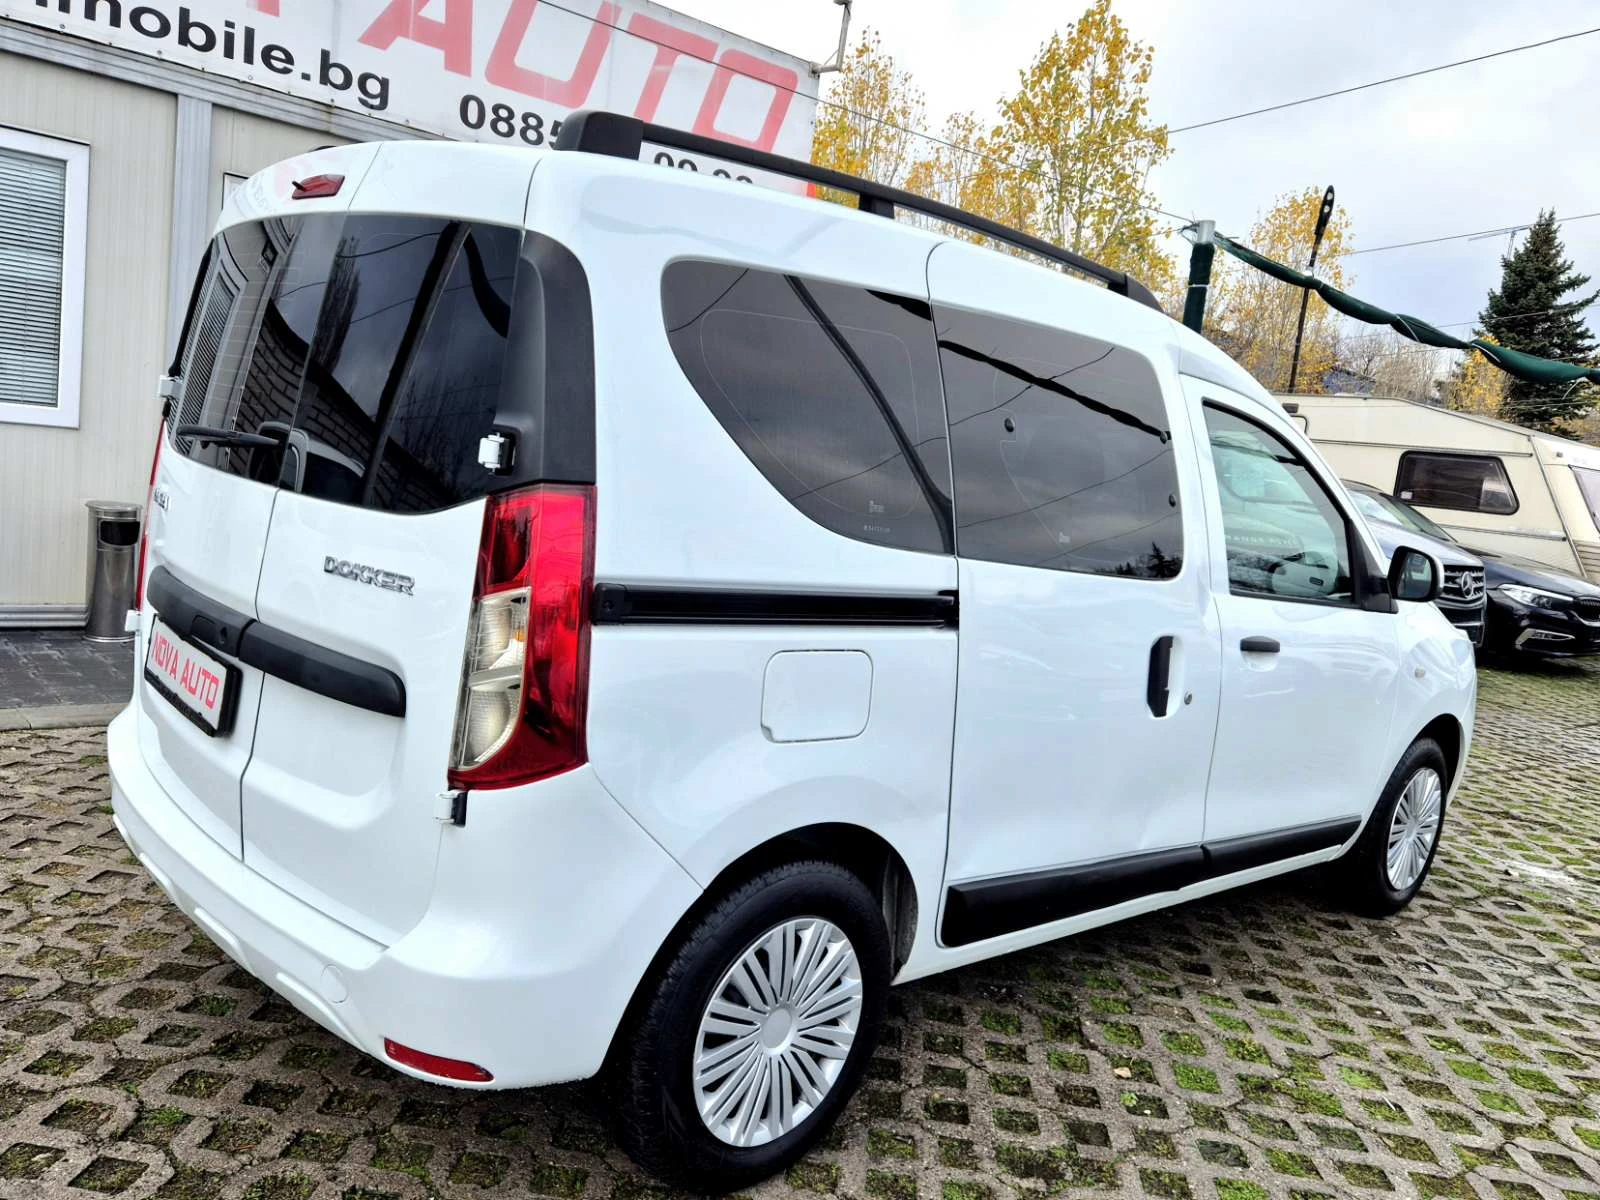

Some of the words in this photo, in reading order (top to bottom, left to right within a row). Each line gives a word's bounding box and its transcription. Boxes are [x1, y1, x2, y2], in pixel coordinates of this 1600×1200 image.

[357, 0, 798, 152] AUTO
[324, 555, 415, 596] DOKKER
[152, 631, 179, 680] NOVA
[180, 657, 220, 709] AUTO
